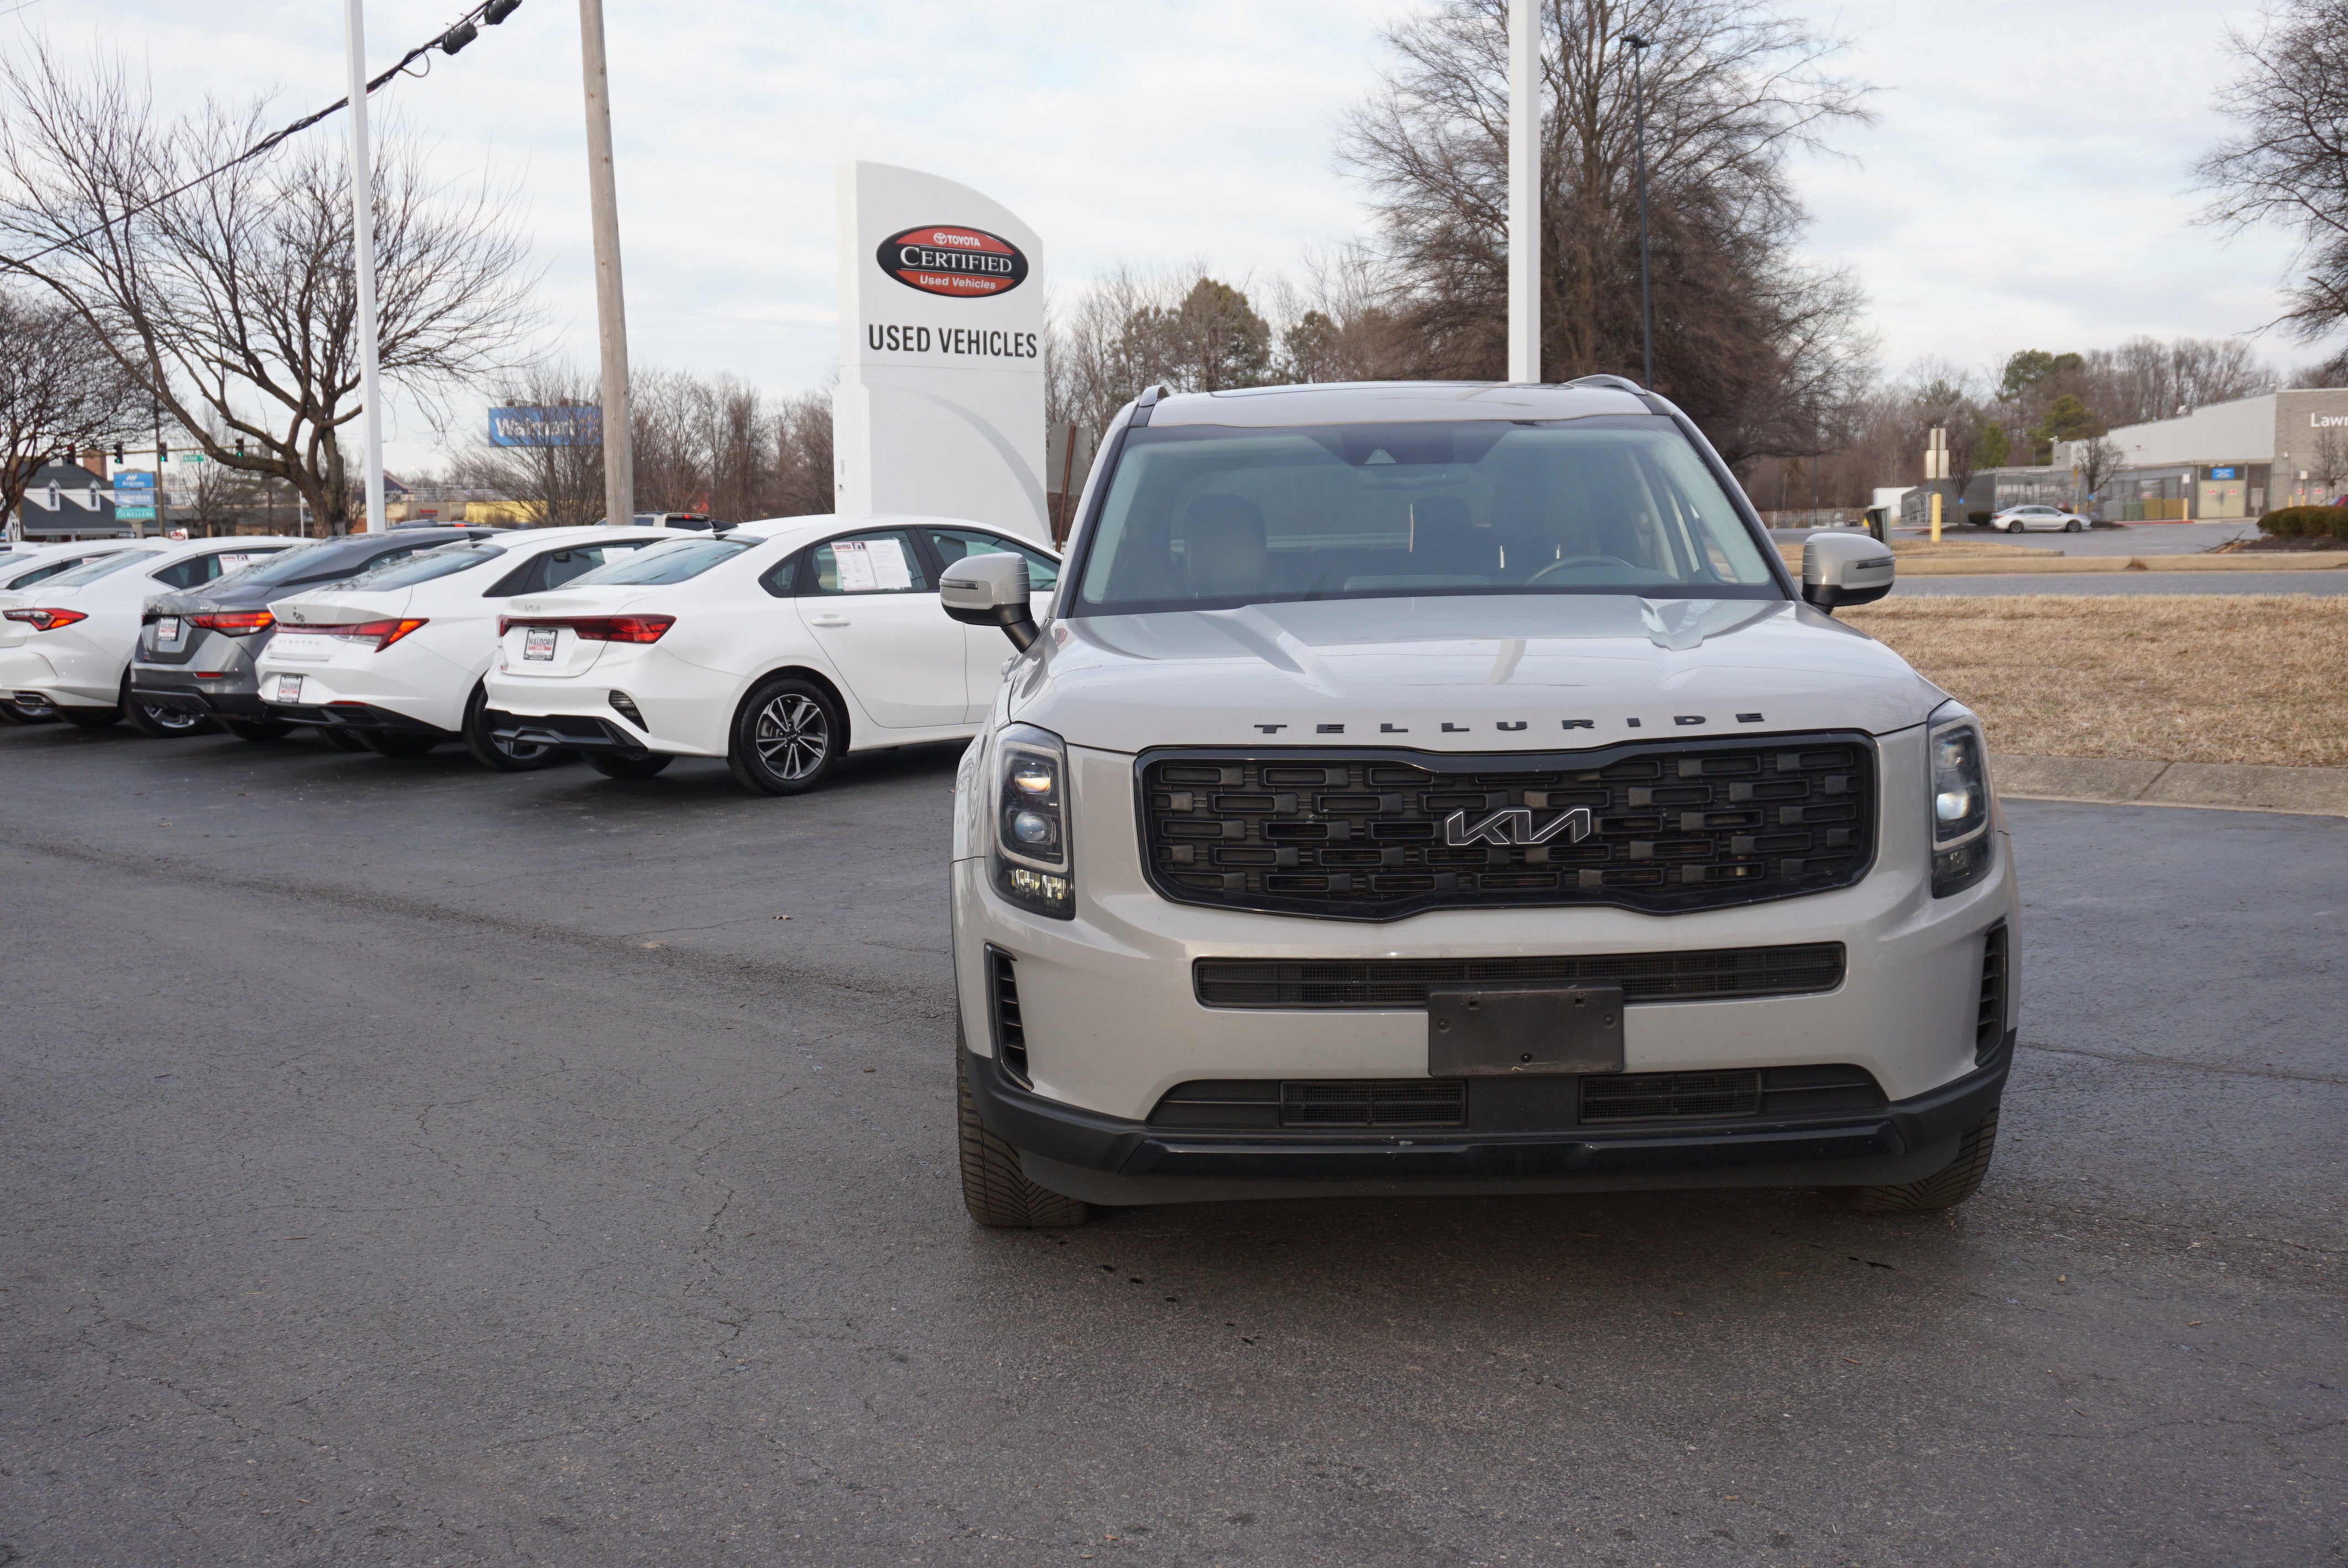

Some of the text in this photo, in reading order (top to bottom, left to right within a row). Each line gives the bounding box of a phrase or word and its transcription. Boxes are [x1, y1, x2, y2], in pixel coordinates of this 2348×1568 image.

[947, 234, 980, 246] TOYOTA
[900, 246, 1012, 272] CERTIFIED
[920, 275, 996, 289] Used Vehicles
[868, 324, 1037, 358] USED VEHICLES
[529, 637, 554, 646] WALDORF
[1254, 712, 1766, 734] TELLURIDE
[1443, 804, 1594, 847] KIA
